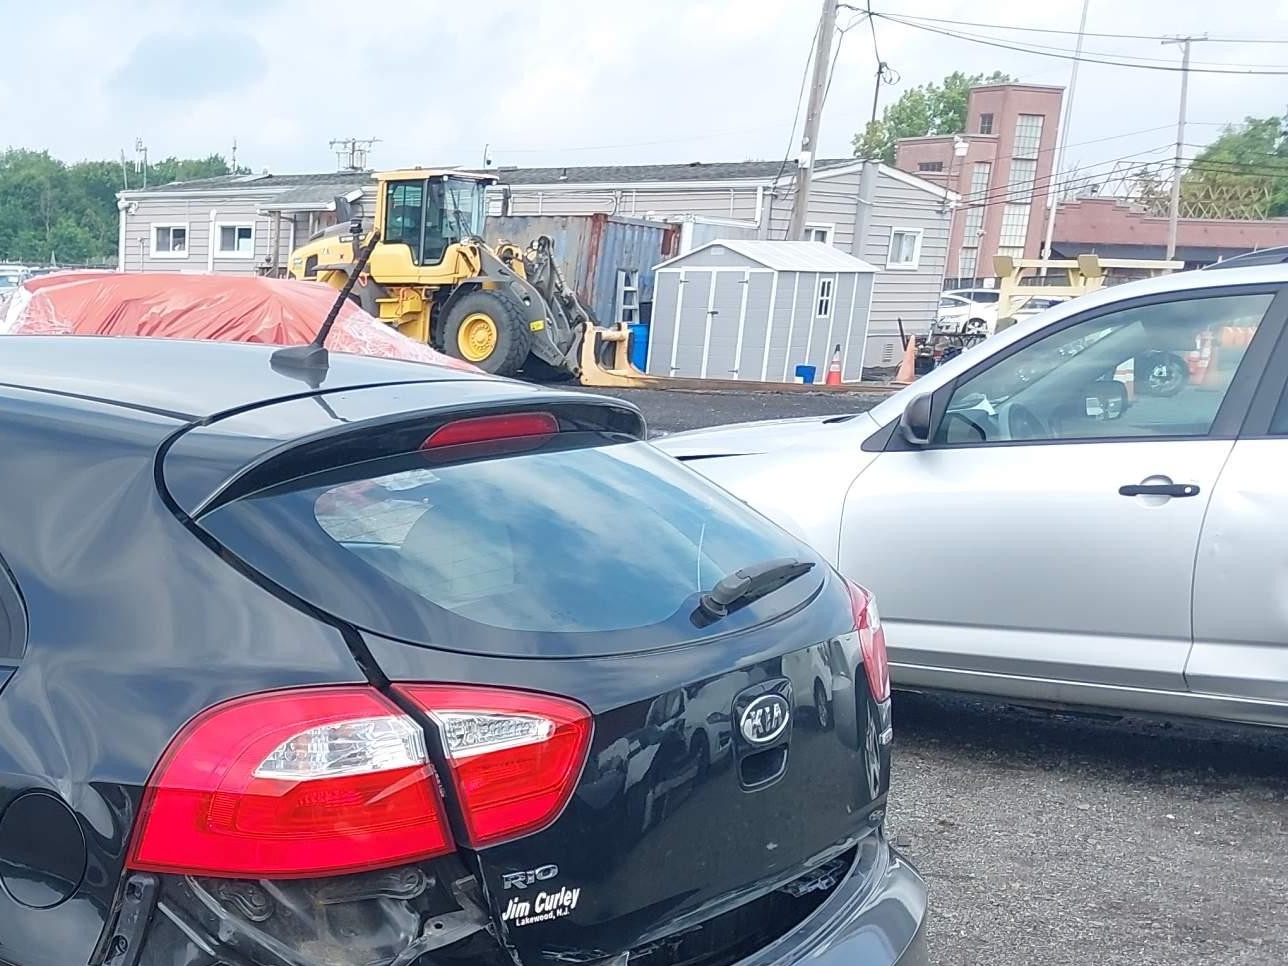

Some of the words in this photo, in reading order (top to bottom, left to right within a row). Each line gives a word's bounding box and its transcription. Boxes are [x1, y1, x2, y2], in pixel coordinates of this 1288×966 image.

[748, 702, 783, 738] KIA
[502, 897, 531, 921] Jim
[535, 886, 581, 914] Curley
[515, 911, 556, 927] Lakewood,
